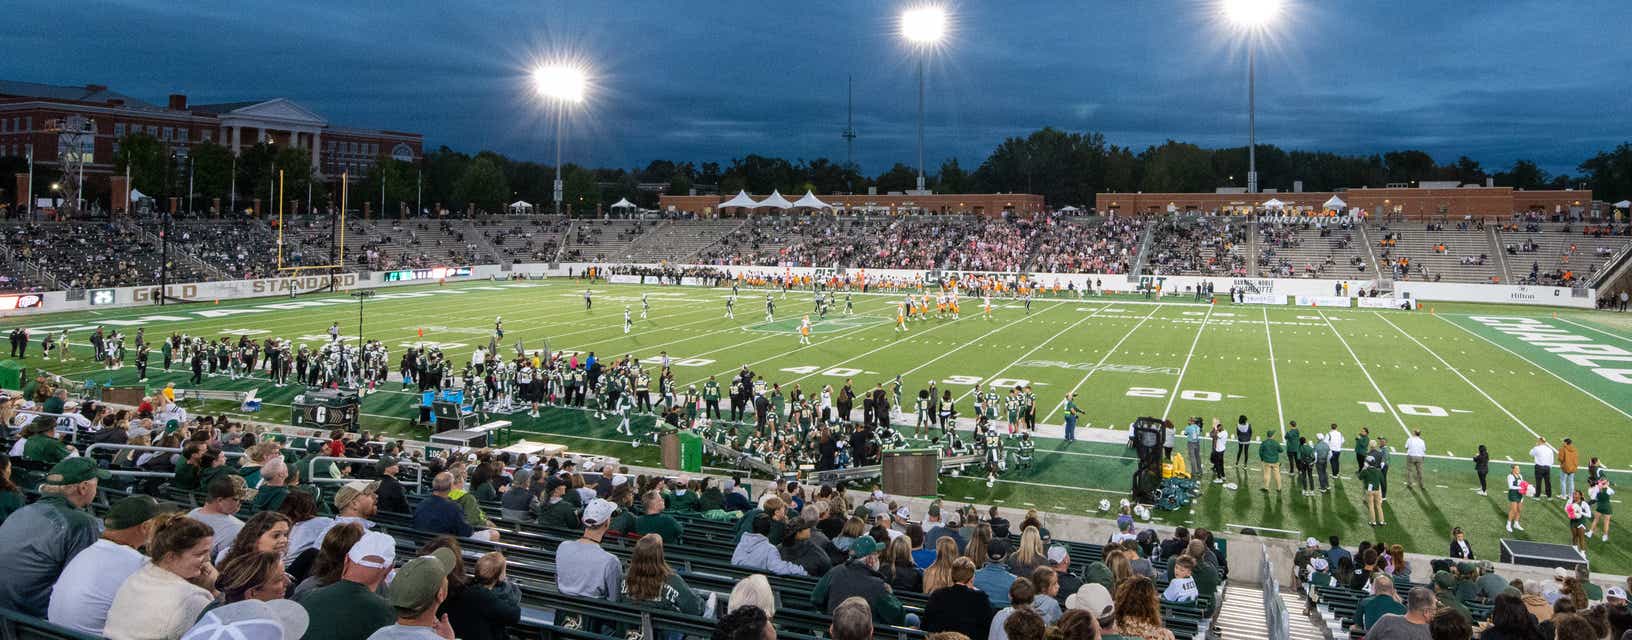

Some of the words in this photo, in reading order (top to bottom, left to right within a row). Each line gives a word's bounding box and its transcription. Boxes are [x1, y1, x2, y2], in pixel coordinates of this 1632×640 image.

[1259, 216, 1298, 224] NINER
[1299, 215, 1351, 225] NATION
[252, 274, 356, 293] STANDARD
[1511, 292, 1535, 300] Hilton
[779, 366, 863, 377] 40
[942, 375, 1028, 388] 30
[1126, 387, 1222, 401] 20
[1357, 401, 1449, 416] 10
